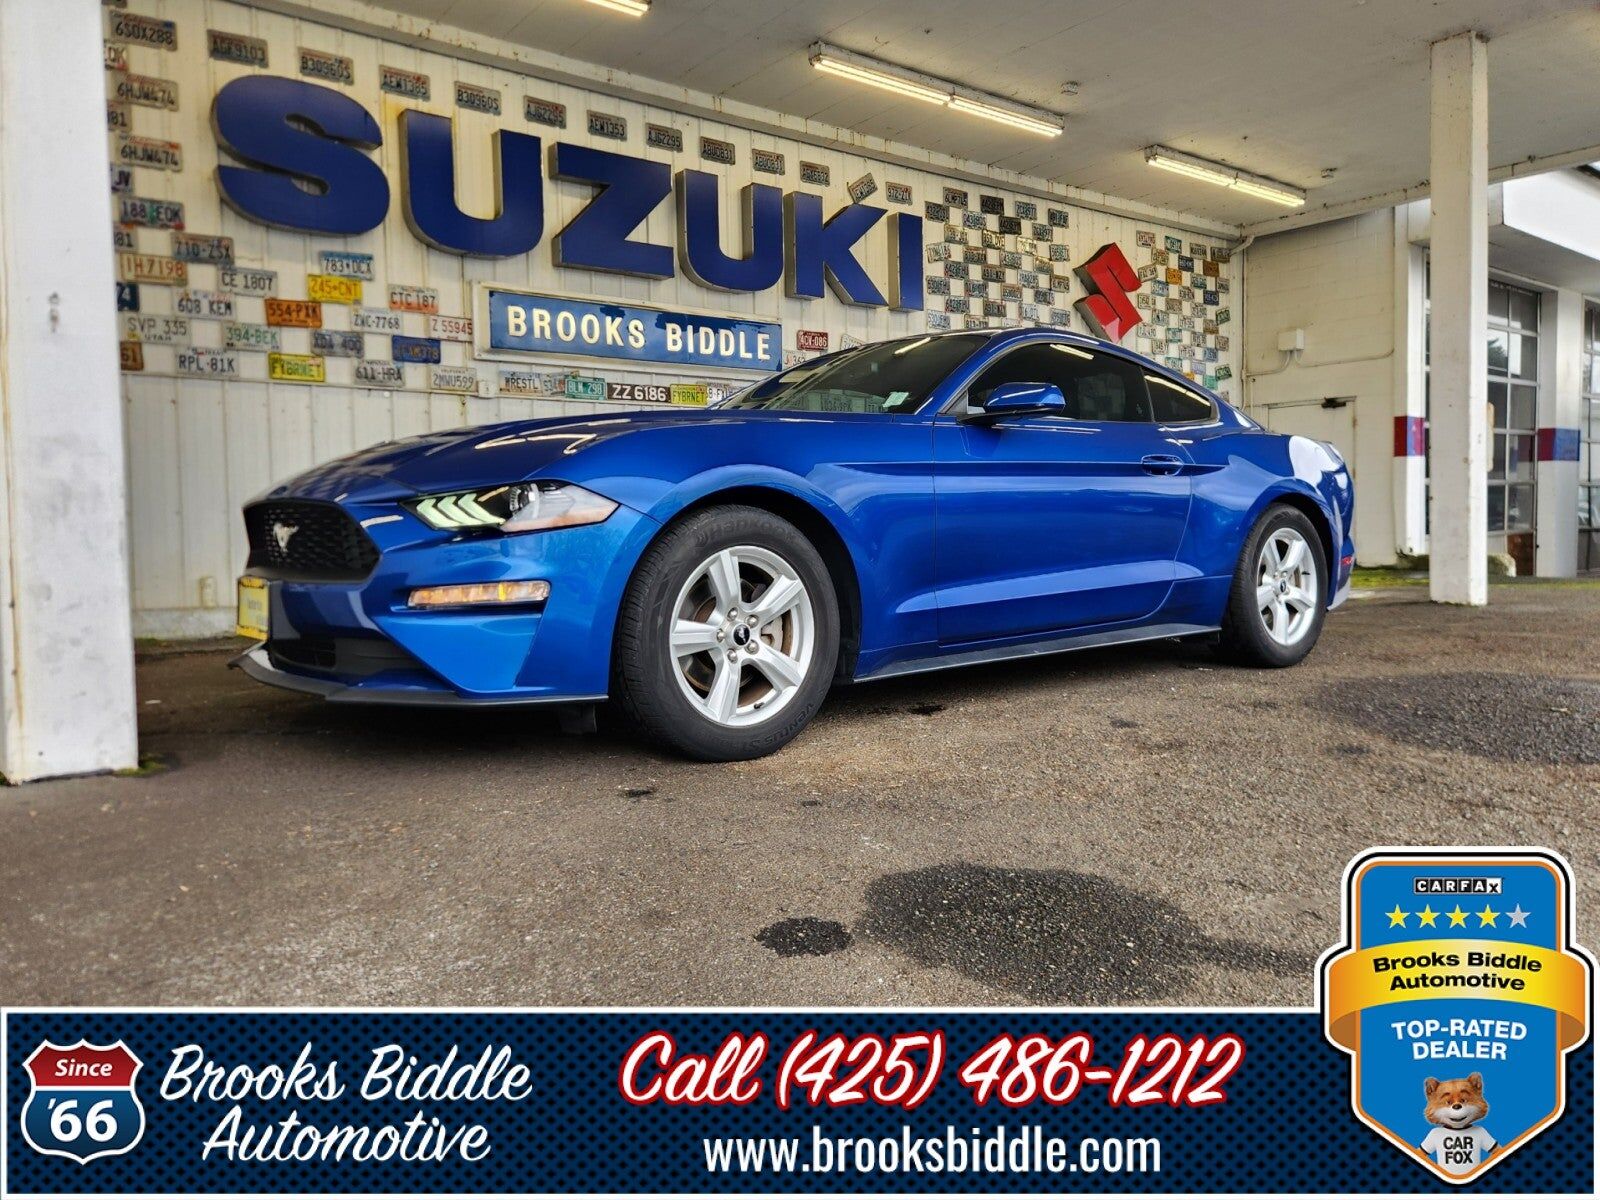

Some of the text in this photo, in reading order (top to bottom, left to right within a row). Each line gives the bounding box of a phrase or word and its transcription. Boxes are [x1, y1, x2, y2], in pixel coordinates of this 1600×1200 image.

[212, 75, 923, 312] SUZUKI
[221, 272, 274, 292] CE 1807
[177, 297, 232, 317] 608 KEM
[162, 319, 188, 336] 335
[507, 305, 770, 361] BROOKS BIDDLE
[611, 384, 667, 402] ZZ 6186
[672, 390, 706, 404] FYBRNET
